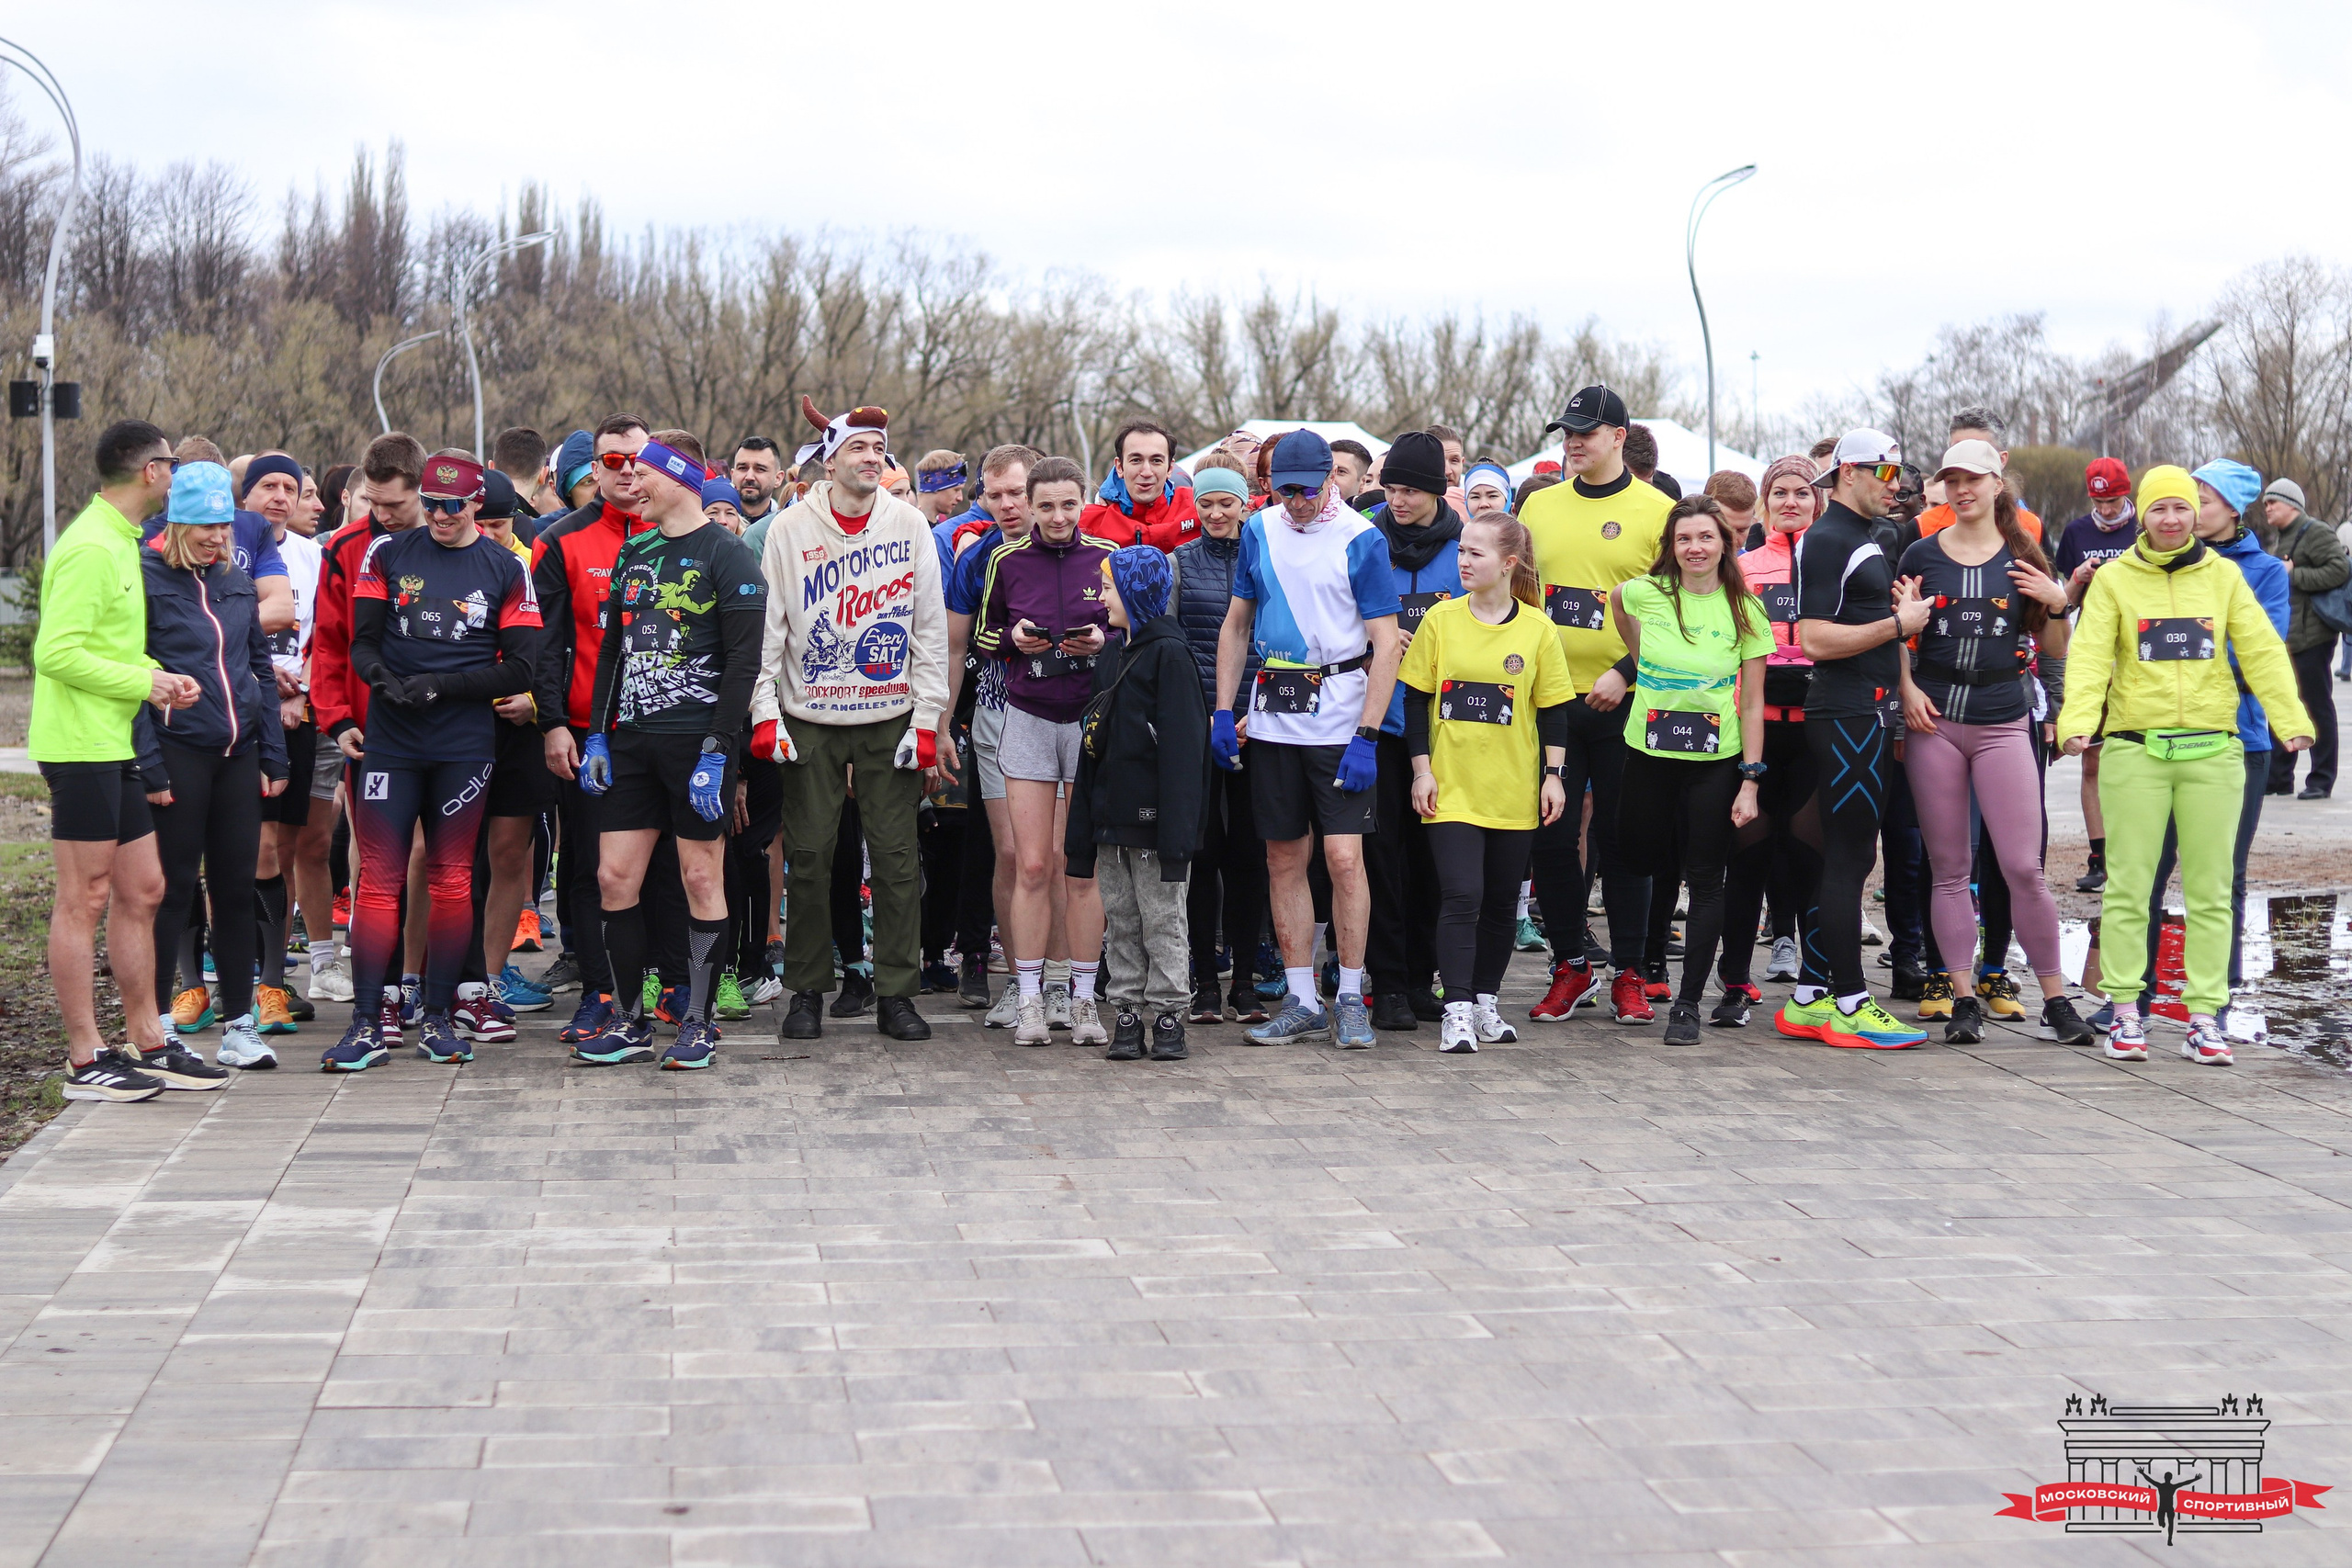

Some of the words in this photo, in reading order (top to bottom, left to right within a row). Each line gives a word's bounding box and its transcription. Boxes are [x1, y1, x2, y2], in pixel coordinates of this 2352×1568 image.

[1181, 519, 1194, 531] HH
[806, 550, 825, 560] 1958
[592, 568, 614, 578] RAV
[804, 540, 910, 613] MOTORCYCLE
[465, 596, 489, 606] adidas
[835, 570, 913, 629] Races
[1777, 596, 1795, 606] 071
[891, 604, 908, 614] MILE
[1562, 600, 1580, 611] 019
[421, 610, 441, 622] 065
[1408, 606, 1427, 617] 018
[1962, 611, 1982, 621] 079
[641, 625, 658, 635] 052
[862, 627, 907, 649] Every
[2166, 632, 2188, 643] 030
[868, 646, 902, 663] SAT.
[1055, 649, 1073, 660] 01
[805, 685, 858, 699] ROCKPORT
[858, 682, 910, 700] speedway
[1279, 686, 1295, 696] 053
[805, 702, 827, 710] LOS
[831, 701, 888, 711] ANGELES
[1467, 695, 1487, 707] 012
[1672, 725, 1692, 736] 044
[2177, 739, 2215, 750] DEMIX
